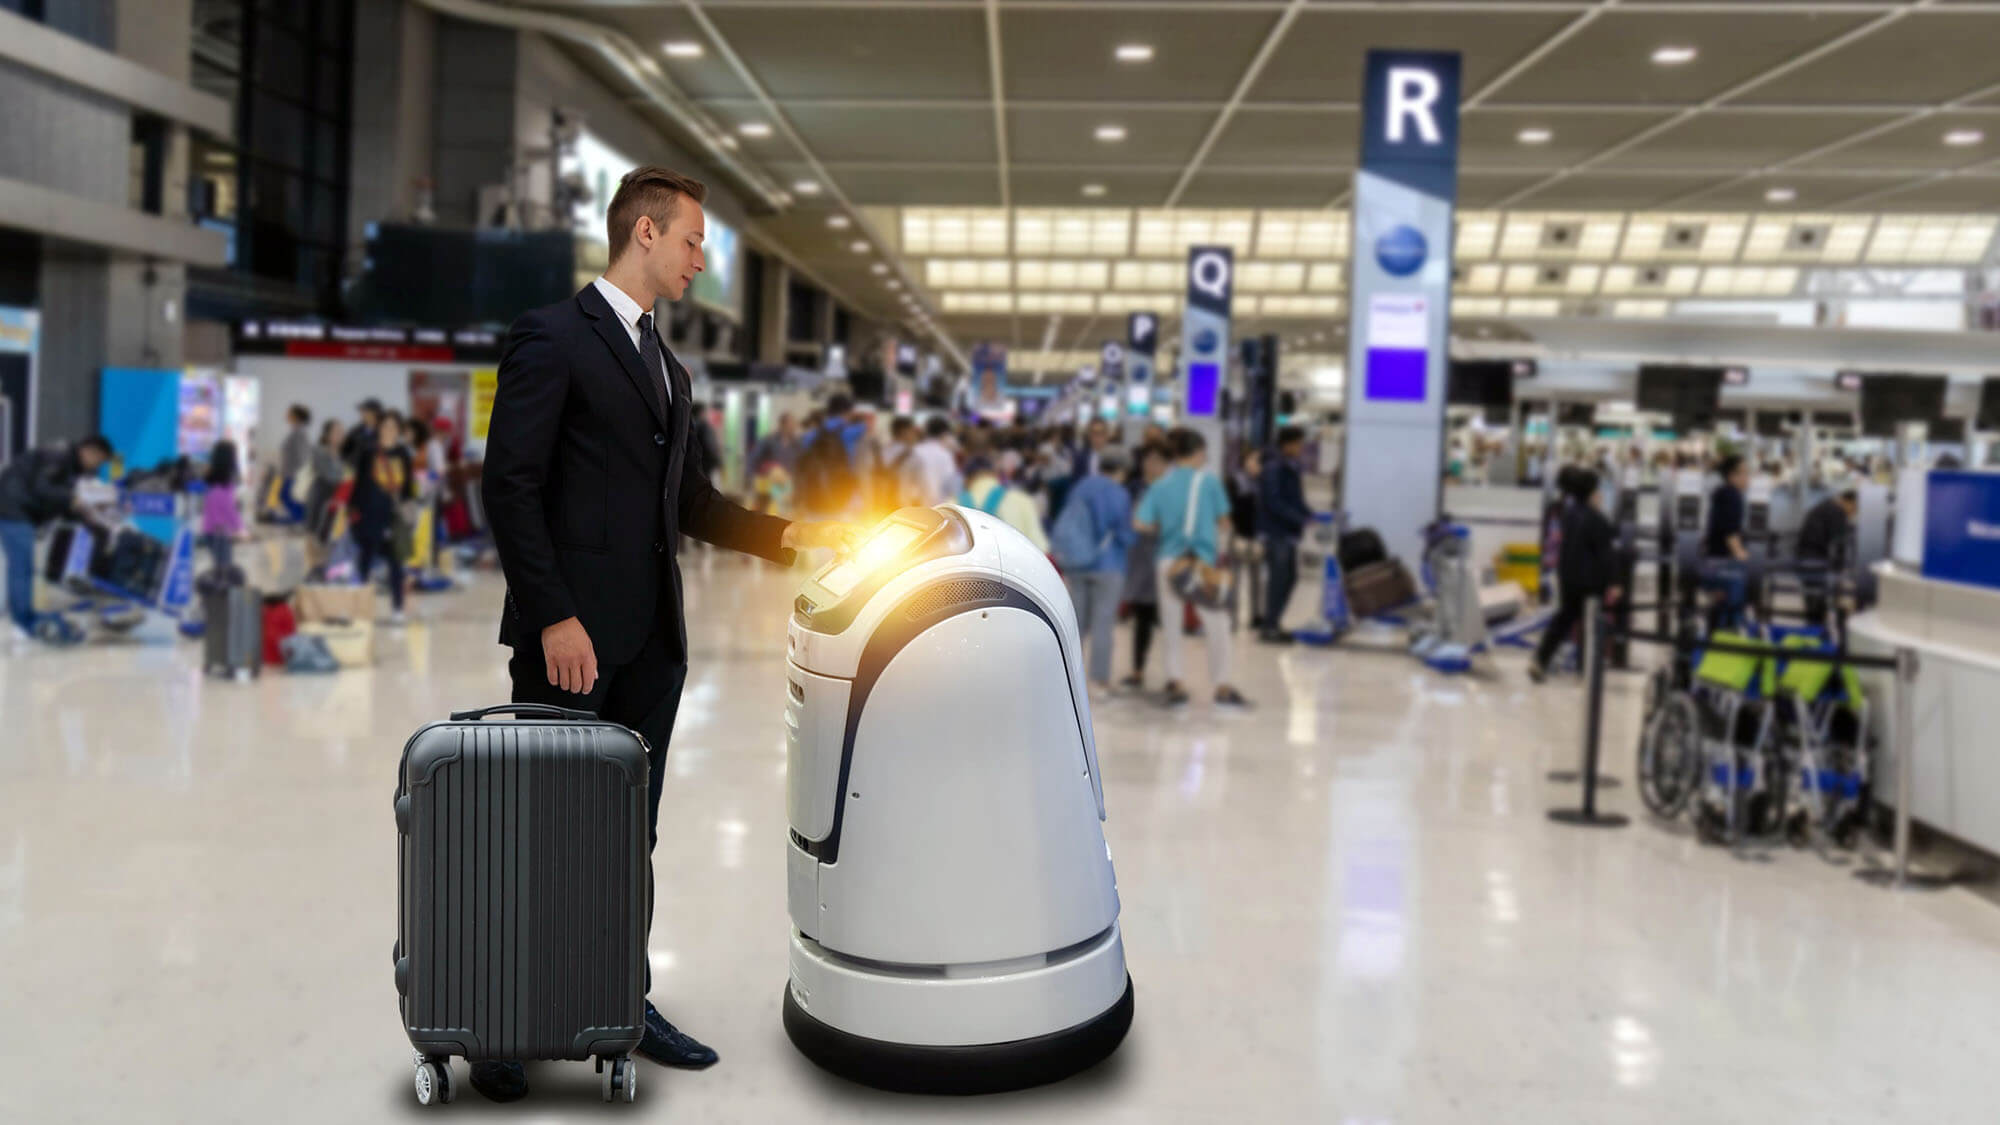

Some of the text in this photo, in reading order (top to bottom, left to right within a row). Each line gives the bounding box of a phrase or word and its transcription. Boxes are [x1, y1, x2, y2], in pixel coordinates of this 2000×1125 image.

[1386, 67, 1441, 143] R
[1192, 252, 1228, 298] Q
[1133, 315, 1153, 340] P
